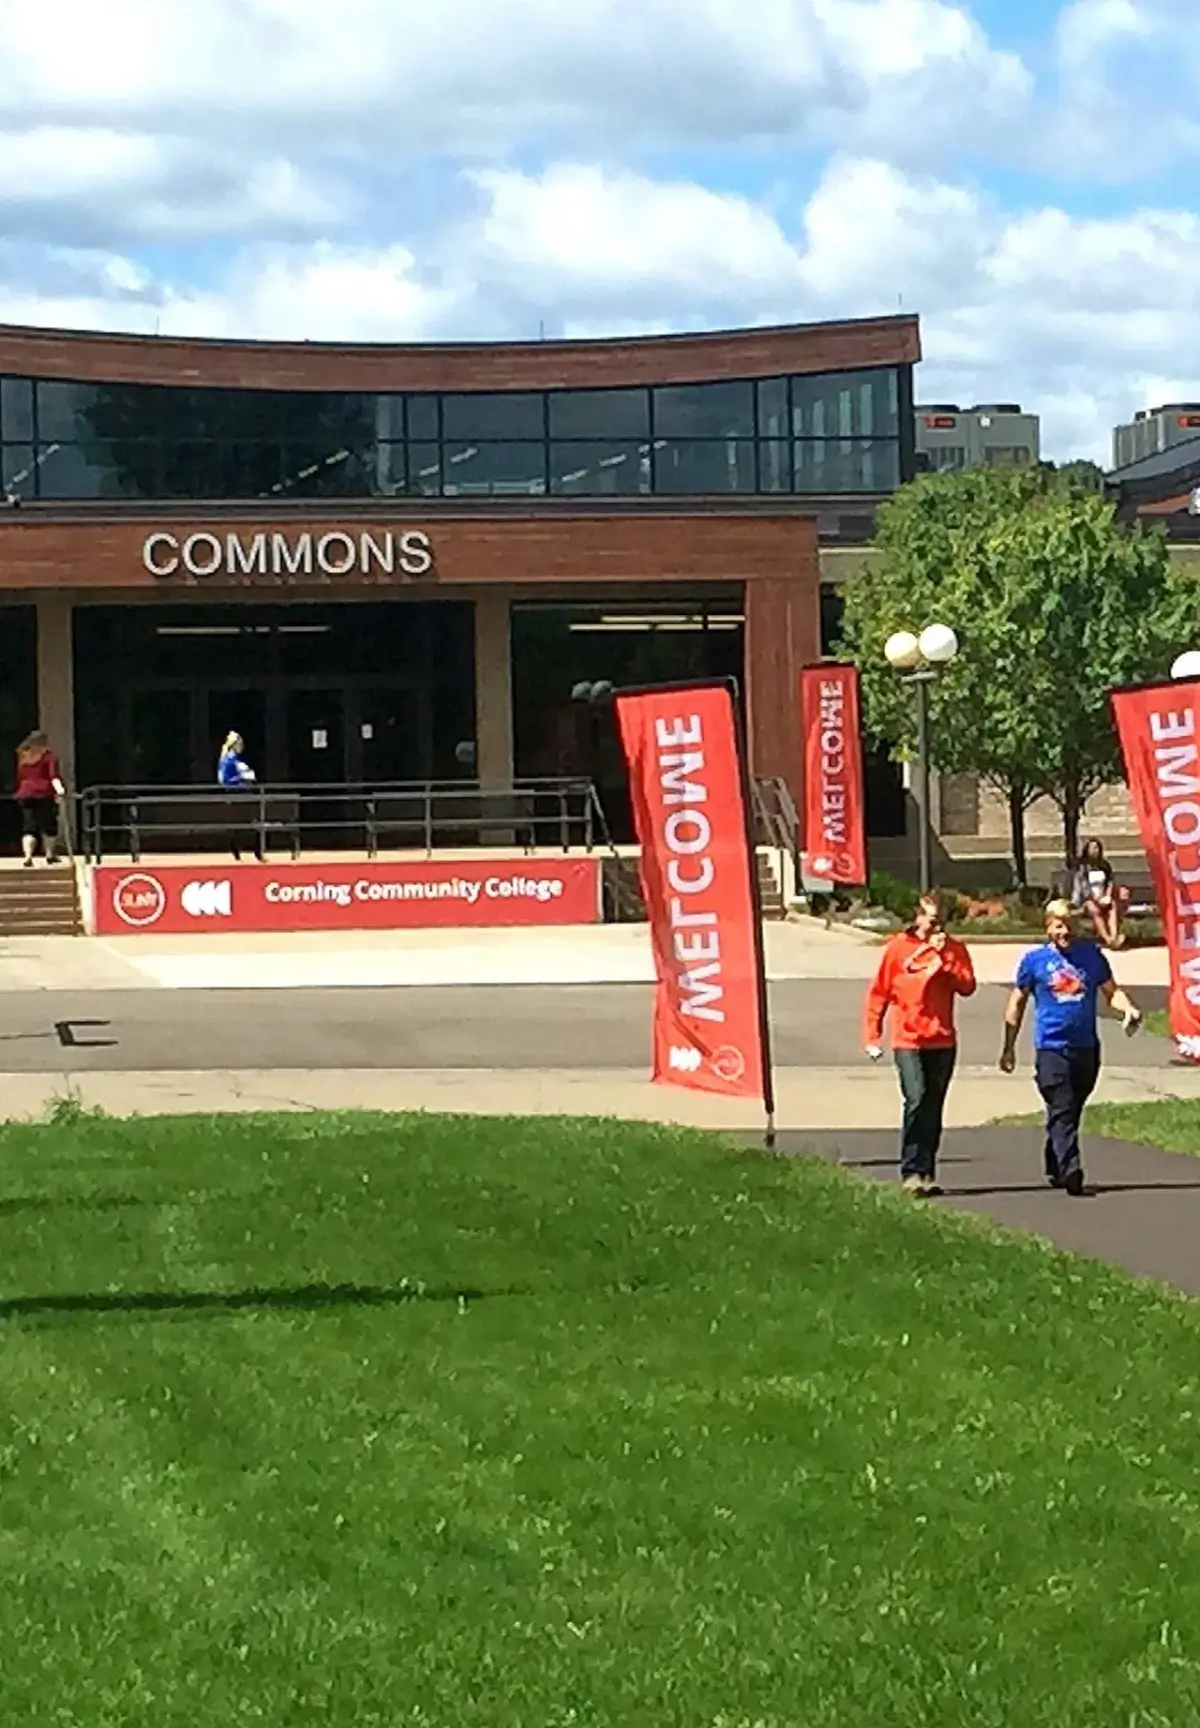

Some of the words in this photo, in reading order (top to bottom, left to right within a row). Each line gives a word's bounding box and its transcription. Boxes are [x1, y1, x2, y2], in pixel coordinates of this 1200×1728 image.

[143, 531, 431, 575] COMMONS
[265, 881, 352, 906] Corning
[354, 878, 481, 903] Community
[485, 876, 563, 902] College
